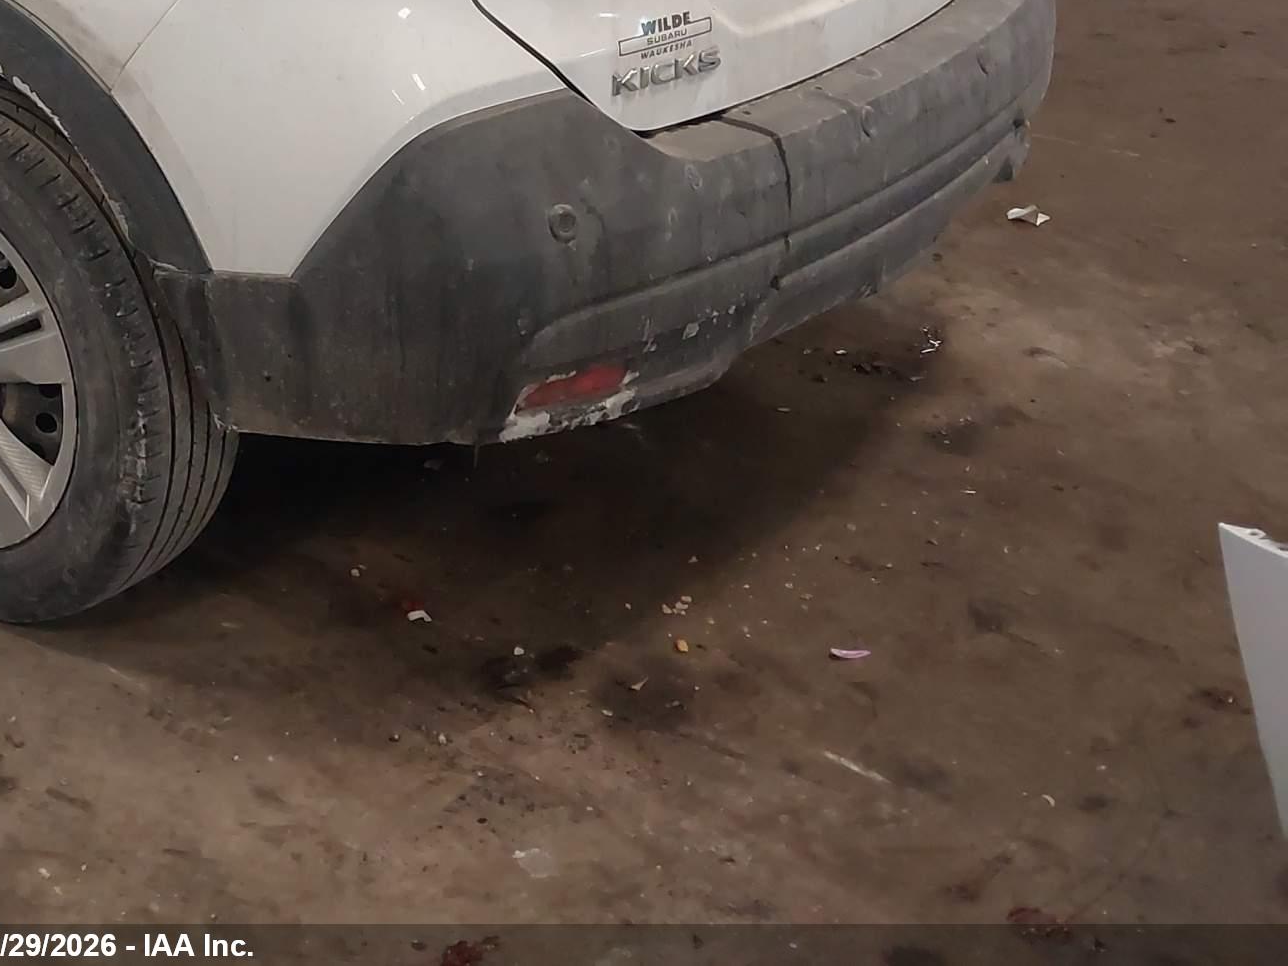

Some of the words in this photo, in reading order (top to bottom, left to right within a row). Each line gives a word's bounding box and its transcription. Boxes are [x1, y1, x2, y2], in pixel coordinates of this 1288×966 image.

[641, 11, 691, 35] WILDE
[646, 28, 688, 45] SUBARU
[640, 40, 693, 60] WAUKESHA
[612, 48, 722, 96] KICKS
